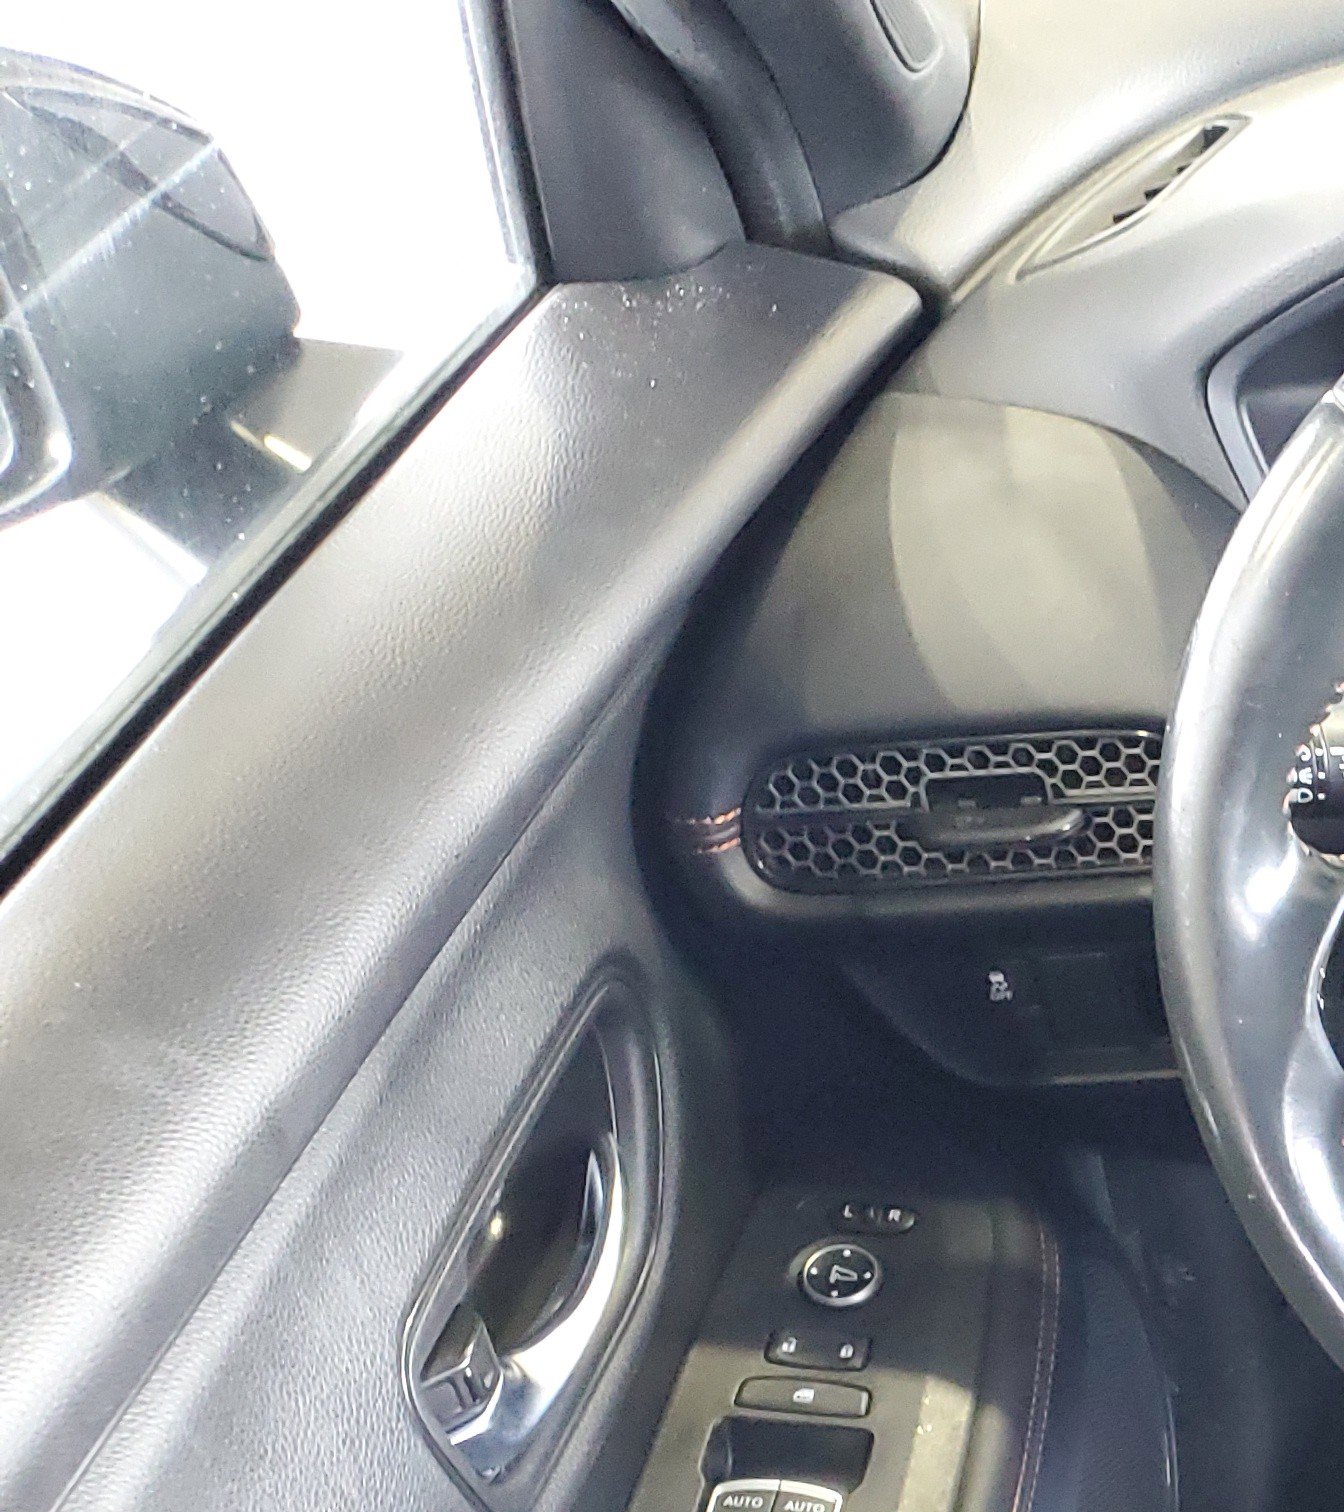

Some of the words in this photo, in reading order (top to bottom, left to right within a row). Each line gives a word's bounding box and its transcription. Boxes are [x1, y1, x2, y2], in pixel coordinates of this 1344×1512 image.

[843, 1205, 853, 1218] L
[888, 1209, 901, 1222] R
[723, 1495, 763, 1509] AUTO
